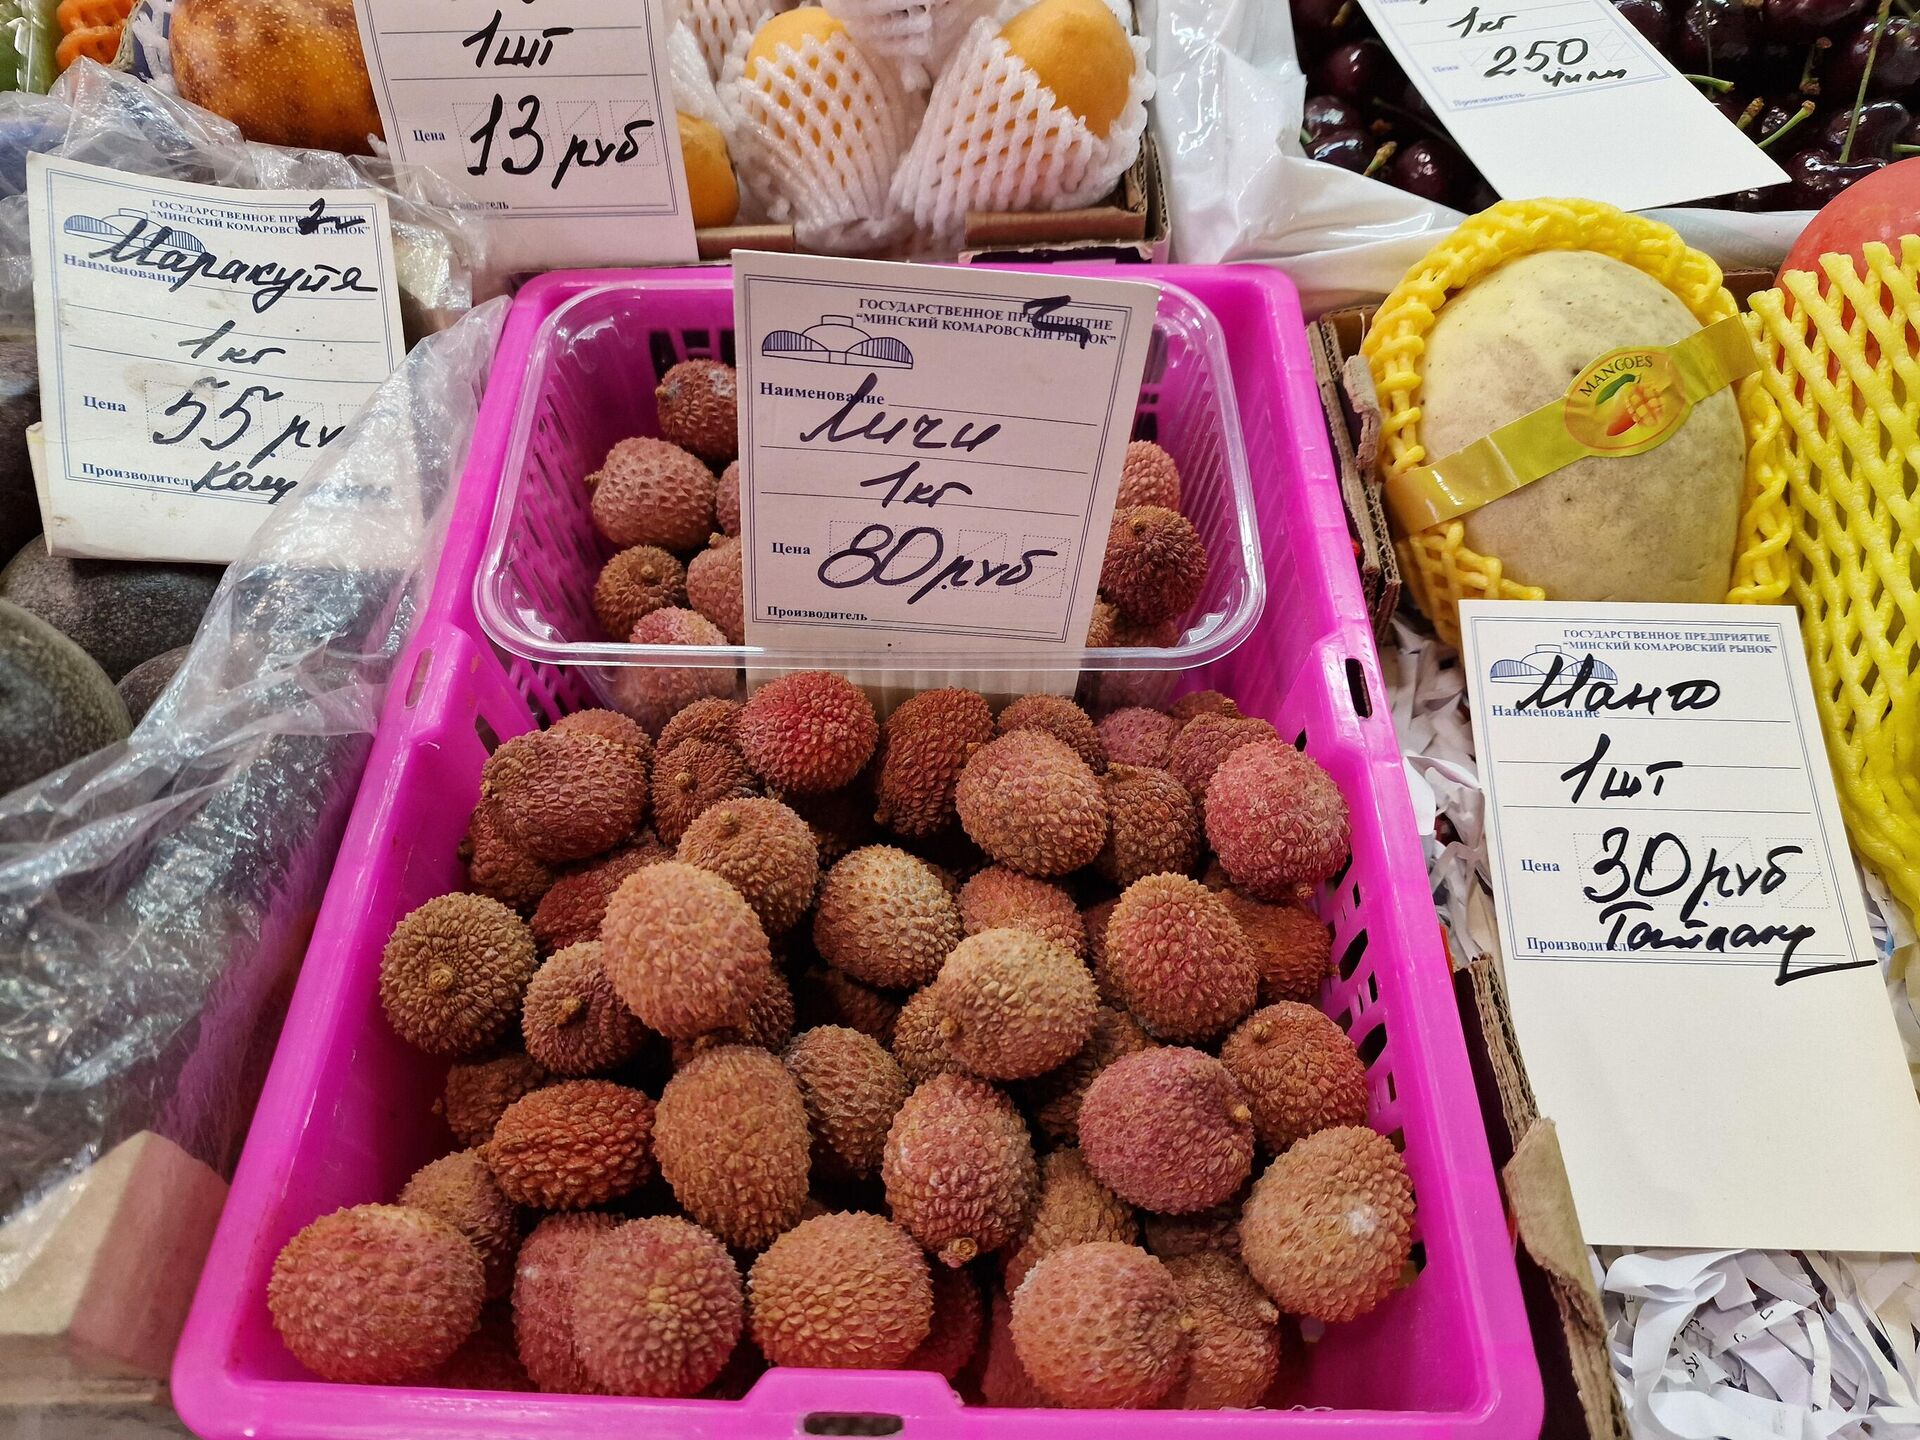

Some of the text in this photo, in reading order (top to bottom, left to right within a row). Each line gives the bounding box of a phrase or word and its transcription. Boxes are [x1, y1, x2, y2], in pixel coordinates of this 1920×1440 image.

[1484, 38, 1589, 78] 250
[413, 93, 655, 189] Цена 13 руб
[152, 199, 276, 223] ГОСУДАРСТВЕННОЕ
[859, 298, 1004, 320] ГОСУДАРСТВЕННОЕ
[1579, 355, 1653, 398] MANGOES
[83, 394, 127, 413] Цена
[153, 376, 284, 451] 55
[800, 372, 1001, 452] Личи
[771, 541, 811, 556] Цена
[767, 605, 868, 622] Производитель
[1563, 629, 1771, 642] ГОСУДАРСТВЕННОЕ ПРЕДПРИЯТИЕ
[1634, 642, 1726, 653] КОМАРОВСКИЙ
[1521, 858, 1560, 873] Цена
[1583, 827, 1691, 904] 30
